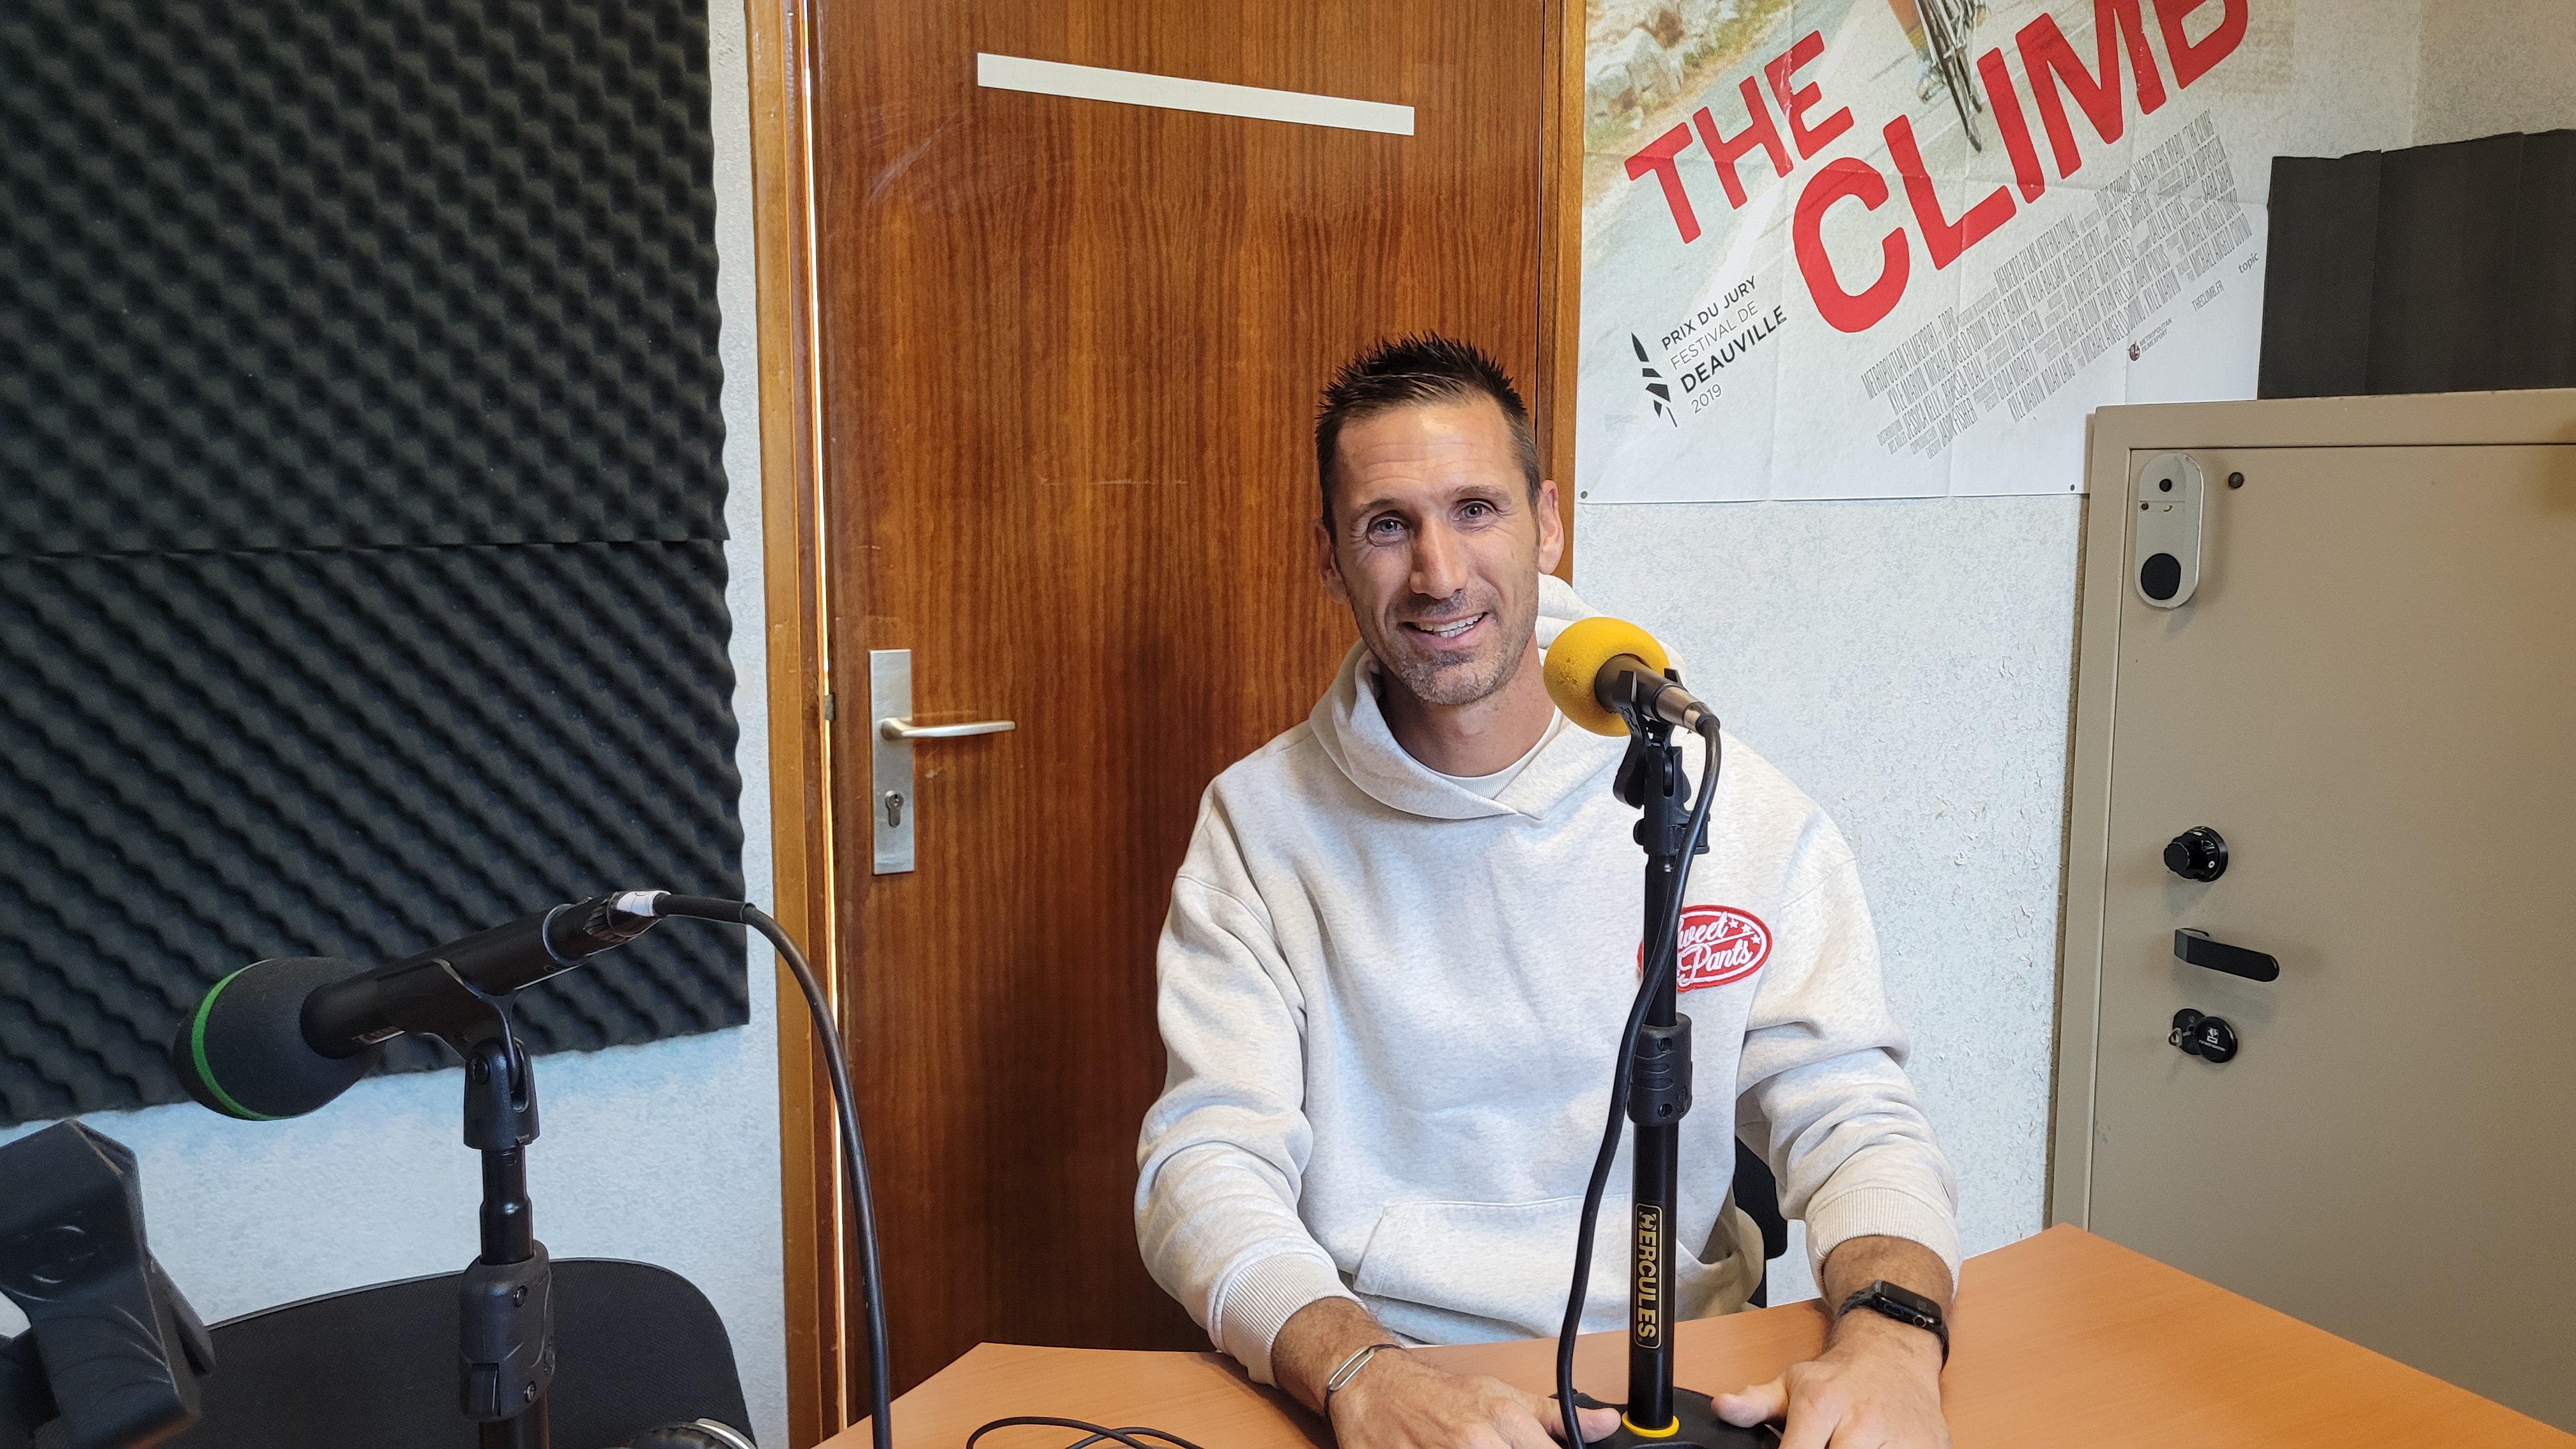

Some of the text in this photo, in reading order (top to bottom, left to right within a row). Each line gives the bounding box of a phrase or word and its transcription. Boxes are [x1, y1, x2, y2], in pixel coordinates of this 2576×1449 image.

[1624, 30, 1854, 244] THE
[1793, 0, 2248, 333] CLIMB
[2178, 155, 2199, 187] ZACH
[2191, 134, 2227, 178] KUPERSTEIN
[2094, 184, 2116, 217] TOPIC
[2131, 151, 2159, 190] WATCH
[2152, 142, 2172, 174] THIS
[2164, 131, 2188, 165] READY
[2198, 172, 2221, 204] SARA
[2212, 160, 2235, 194] SHAW
[2145, 208, 2172, 245] CALLAN
[2165, 194, 2190, 229] STOKES
[2178, 214, 2207, 252] MICHAEL
[2198, 199, 2225, 236] ANGELO
[2188, 240, 2217, 278] MICHAEL
[2209, 226, 2235, 262] ANGELO
[2228, 211, 2253, 247] COVINO
[1992, 254, 2026, 296] MEMENTO
[2018, 242, 2042, 276] FILMS
[2034, 213, 2080, 264] INTERNATIONAL
[2060, 281, 2079, 312] JON
[2071, 264, 2100, 303] NATCHEZ
[2094, 249, 2121, 285] MARTIN
[2239, 253, 2258, 273] topic
[1662, 275, 1756, 350] PRIX DU JURY
[1886, 383, 1907, 416] KYLE
[1899, 366, 1929, 406] MARVIN
[1922, 348, 1952, 387] MICHAEL
[1944, 330, 1973, 370] ANGELO
[1965, 314, 1993, 353] COVINO
[1986, 301, 2010, 336] GAYLE
[2002, 286, 2030, 323] RANKIN
[2023, 273, 2046, 307] TALIA
[2039, 256, 2068, 295] BALSAM
[2062, 240, 2089, 277] GEORGE
[2081, 226, 2106, 261] WENDT
[2103, 206, 2131, 243] JUDITH
[2055, 311, 2084, 349] MICHAEL
[2077, 296, 2103, 332] BLOOM
[2096, 284, 2118, 317] RYAN
[2144, 242, 2170, 279] PINCUS
[2079, 326, 2108, 364] MICHAEL
[2100, 308, 2131, 348] ANGELO
[2142, 283, 2162, 314] KYLE
[2154, 268, 2181, 305] MARVIN
[2191, 280, 2224, 312] THECLIMB.FR
[1671, 300, 1758, 370] FESTIVAL DE
[1680, 305, 1787, 393] DEAUVILLE
[1860, 346, 1909, 400] METROPOLITAN
[1901, 321, 1942, 369] FILMEXPORT
[1937, 305, 1960, 340] TOPIC
[2004, 322, 2027, 356] LINDA
[2020, 309, 2045, 344] COHEN
[2140, 318, 2172, 347] METROPOLITAN
[2142, 328, 2167, 353] FILMEXPORT
[1691, 384, 1722, 413] 2019
[1900, 401, 1930, 440] JESSICA
[1922, 388, 1945, 423] KELLY
[1962, 354, 1988, 390] DEALY
[1993, 366, 2016, 400] GILDA
[2007, 347, 2039, 387] MORATTI
[2006, 351, 2076, 422] KYLE MARVIN NOAH LANG
[1950, 395, 1978, 434] FISHER
[1678, 912, 1729, 949] weet
[1678, 939, 1753, 987] Pants
[1637, 1211, 1657, 1338] HERCULES
